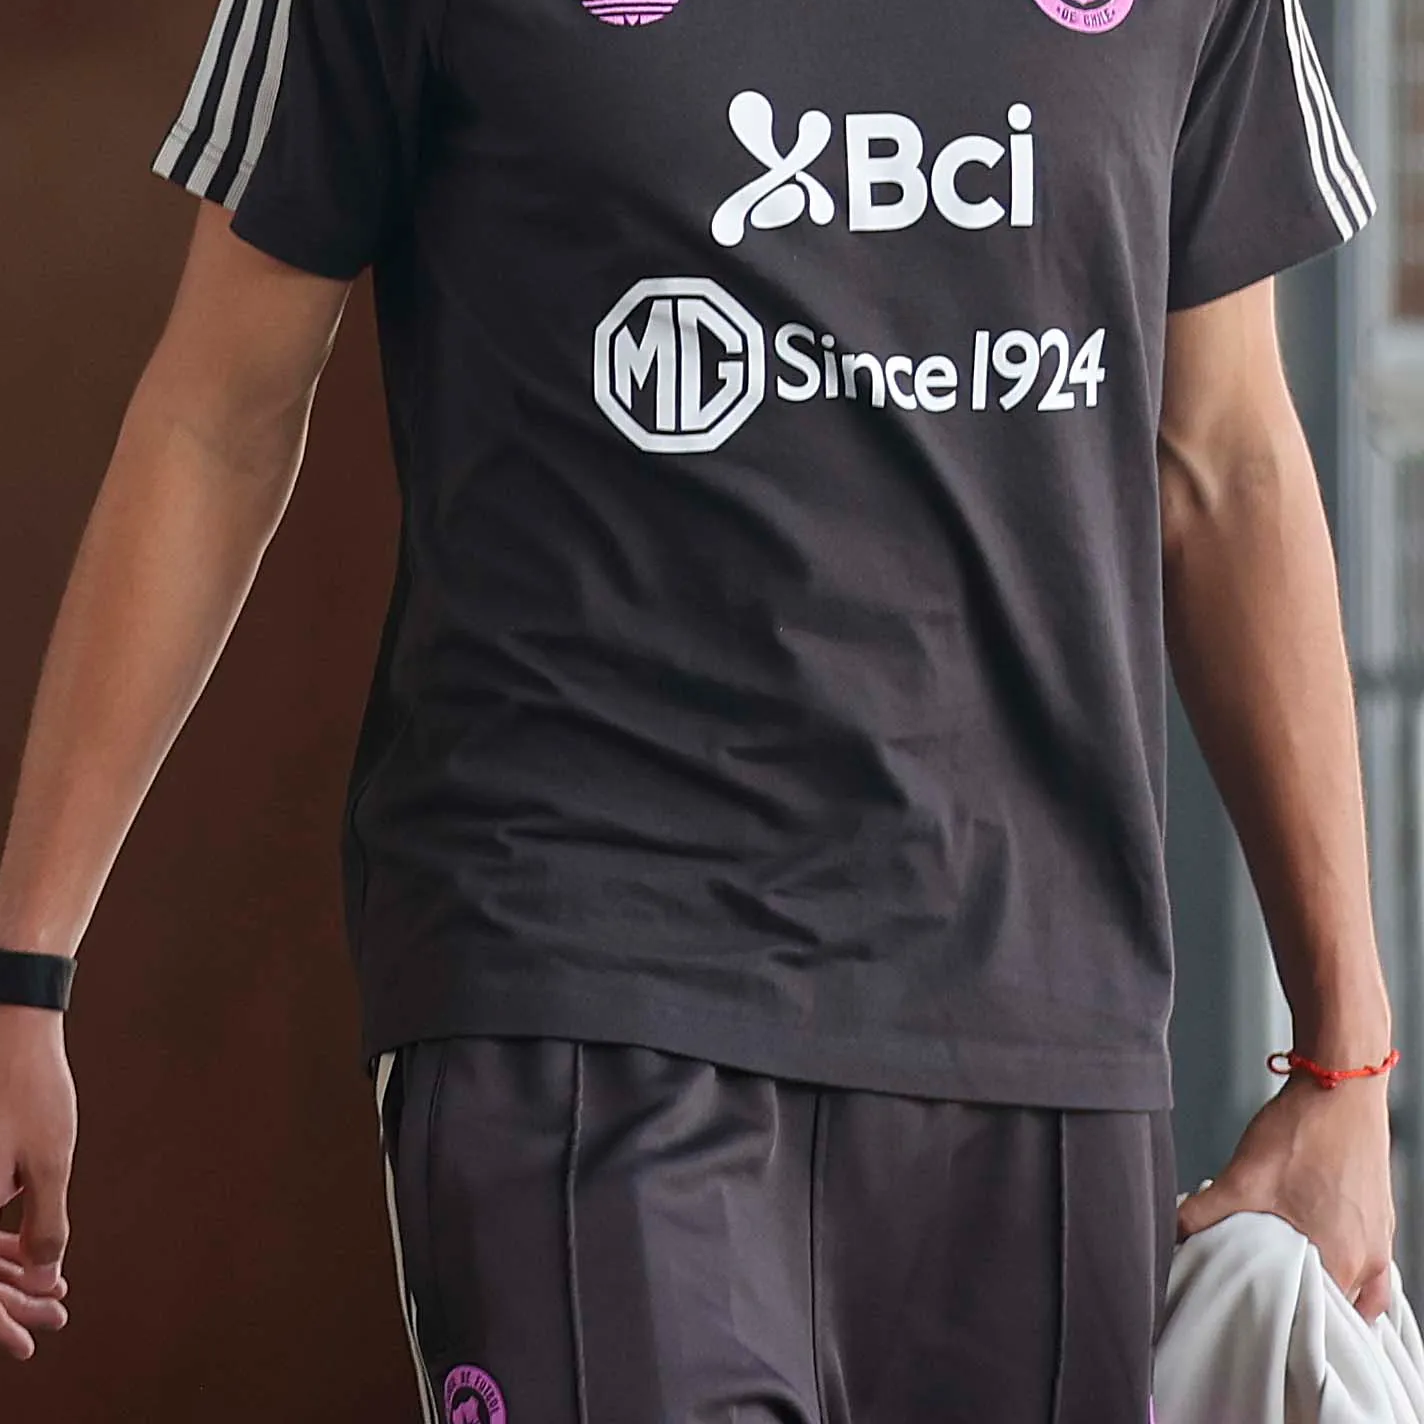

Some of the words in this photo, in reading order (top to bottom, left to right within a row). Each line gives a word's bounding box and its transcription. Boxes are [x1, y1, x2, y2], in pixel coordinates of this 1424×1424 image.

[844, 102, 1035, 233] Bci
[610, 293, 749, 435] MG
[773, 321, 958, 413] Since
[970, 327, 1107, 412] 1924
